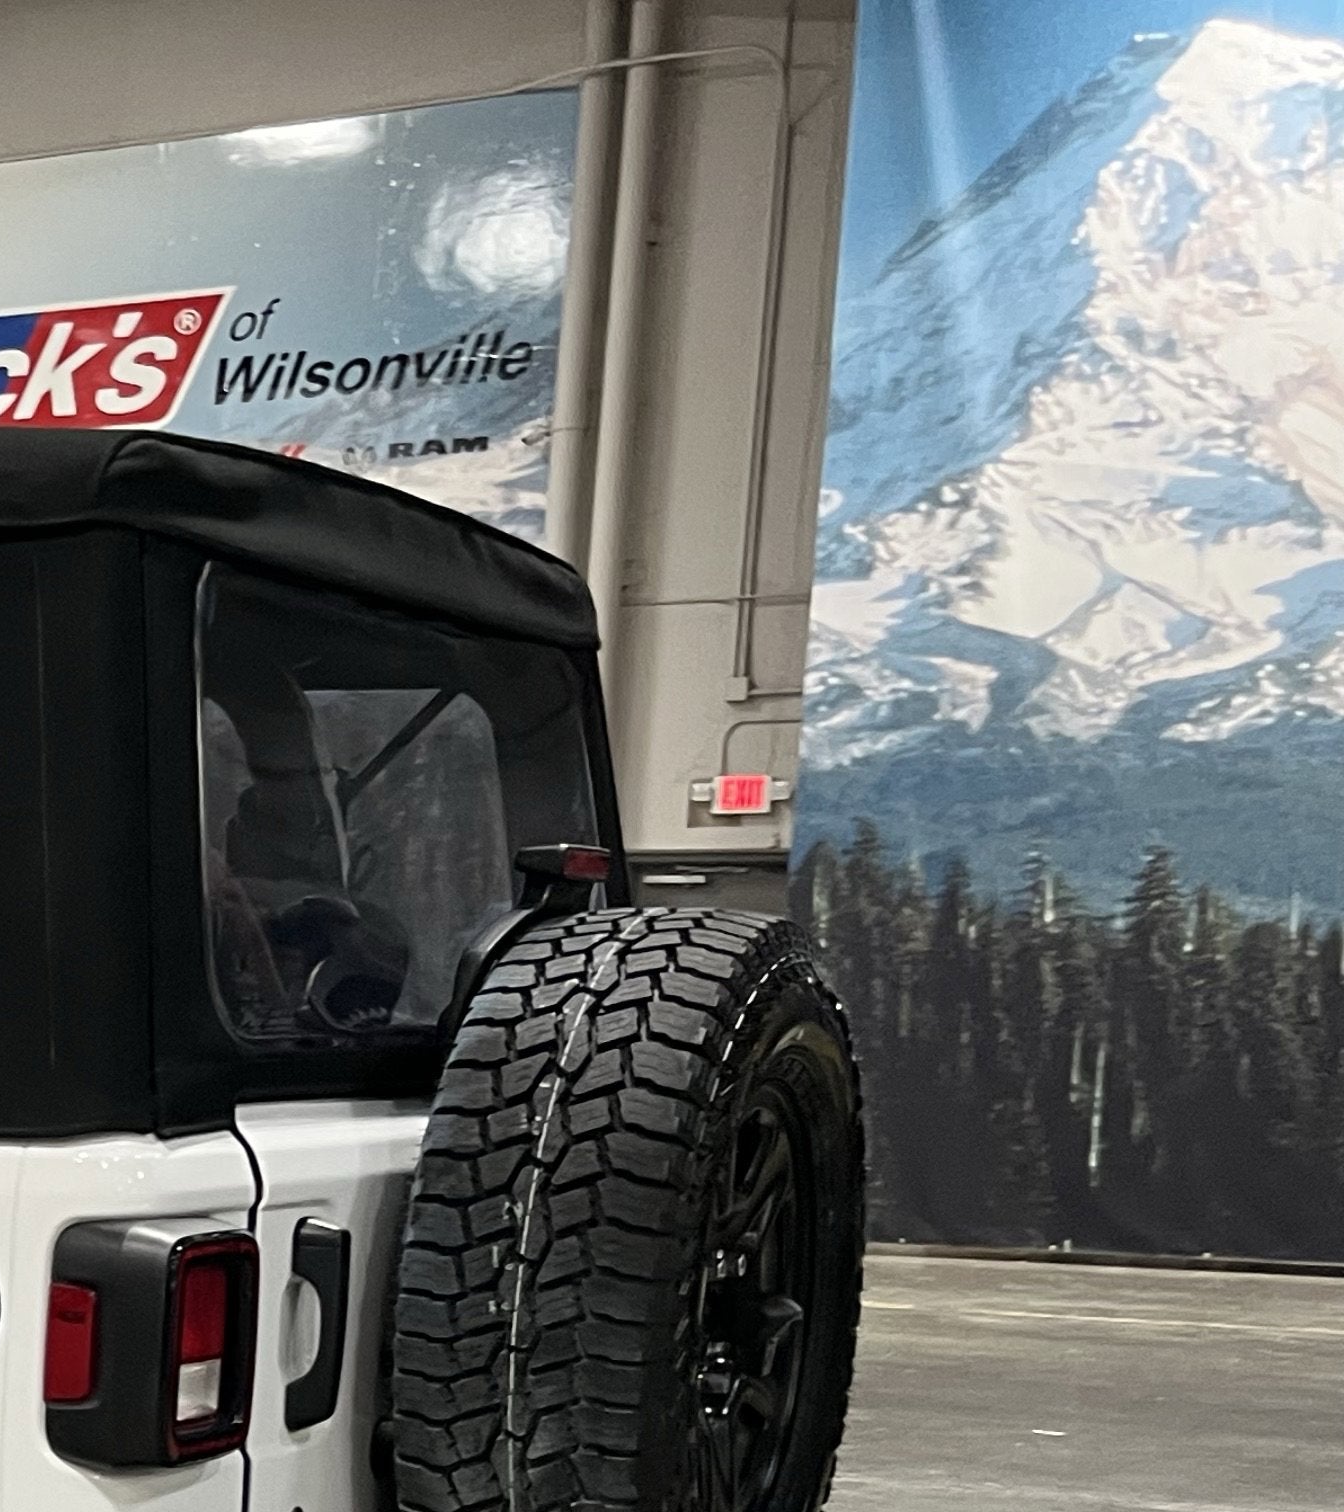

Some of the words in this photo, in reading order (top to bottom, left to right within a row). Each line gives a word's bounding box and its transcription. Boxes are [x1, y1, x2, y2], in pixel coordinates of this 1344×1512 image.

[229, 298, 280, 342] of
[214, 329, 532, 405] Wilsonville
[388, 436, 489, 460] RAM
[720, 778, 765, 808] EXIT
